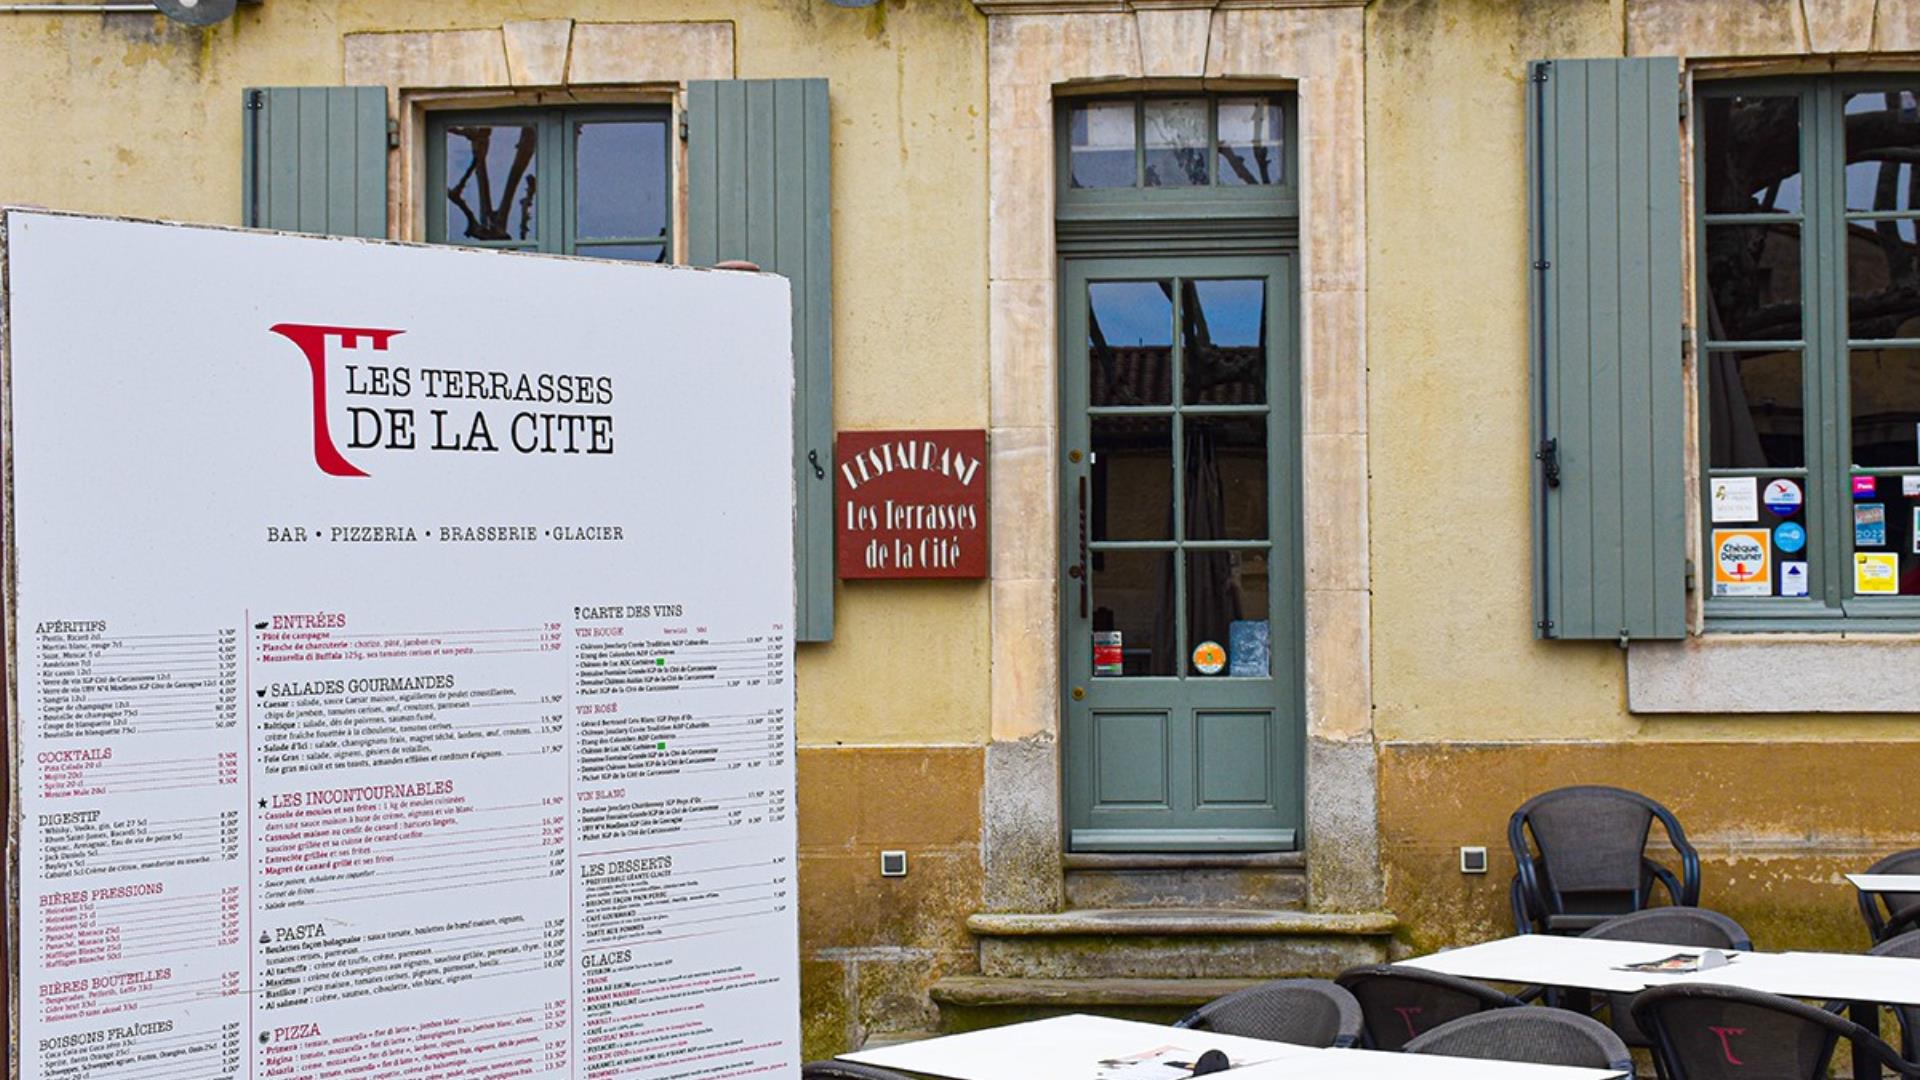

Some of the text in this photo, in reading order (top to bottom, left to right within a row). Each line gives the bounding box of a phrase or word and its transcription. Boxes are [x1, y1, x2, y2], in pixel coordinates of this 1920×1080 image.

[345, 365, 613, 405] LES TERRASSES
[346, 406, 614, 454] DE LA CITE
[841, 440, 982, 491] RESTAURANT
[847, 500, 977, 531] Les Terrasses
[267, 526, 624, 543] BAR PIZZERIA BRASSERIE GLACIER
[865, 535, 960, 568] de la Cité
[1721, 552, 1762, 563] Déjeuner
[1723, 543, 1760, 553] Chèque
[272, 612, 346, 630] ENTRÉES
[582, 605, 684, 620] CARTE DES VINS
[36, 618, 106, 634] APÉRITIFS
[271, 674, 454, 698] SALADES GOURMANDES
[36, 748, 112, 764] COCKTAILS
[272, 780, 454, 809] LES INCONTOURNABLES
[38, 810, 100, 826] DIGESTIF
[581, 856, 672, 878] LES DESSERTS
[38, 880, 164, 908] BIÈRES PRESSIONS
[276, 924, 326, 942] PASTA
[582, 950, 632, 969] GLACES
[38, 967, 172, 997] BIÈRES BOUTEILLES
[38, 1029, 105, 1051] BOISSONS
[274, 1023, 321, 1043] PIZZA
